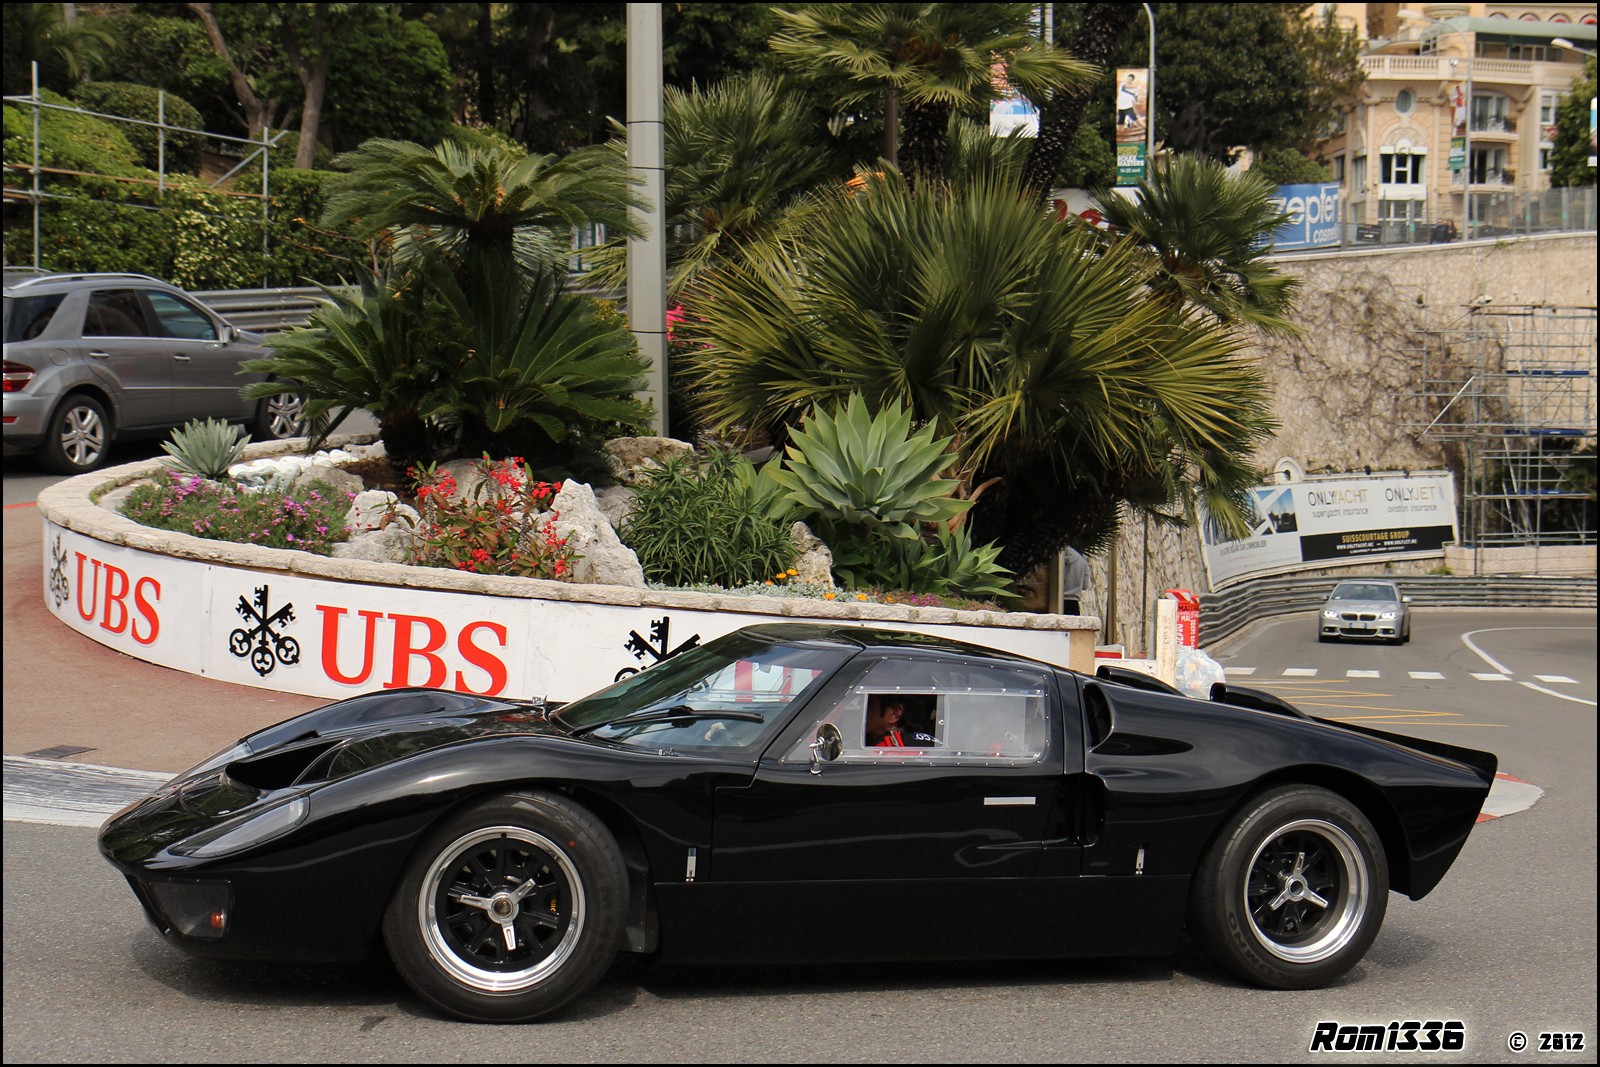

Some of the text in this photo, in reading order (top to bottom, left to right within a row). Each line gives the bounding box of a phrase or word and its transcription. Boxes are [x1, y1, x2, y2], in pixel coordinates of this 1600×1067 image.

[1308, 489, 1368, 506] ONLYYACHT
[1385, 486, 1435, 502] ONLYJET
[1312, 507, 1369, 519] superyacht insurance
[1387, 503, 1437, 513] aviation insurance
[1342, 530, 1410, 543] SUISSCOURTAGE GROUP
[74, 551, 161, 645] UBS
[316, 604, 508, 696] UBS
